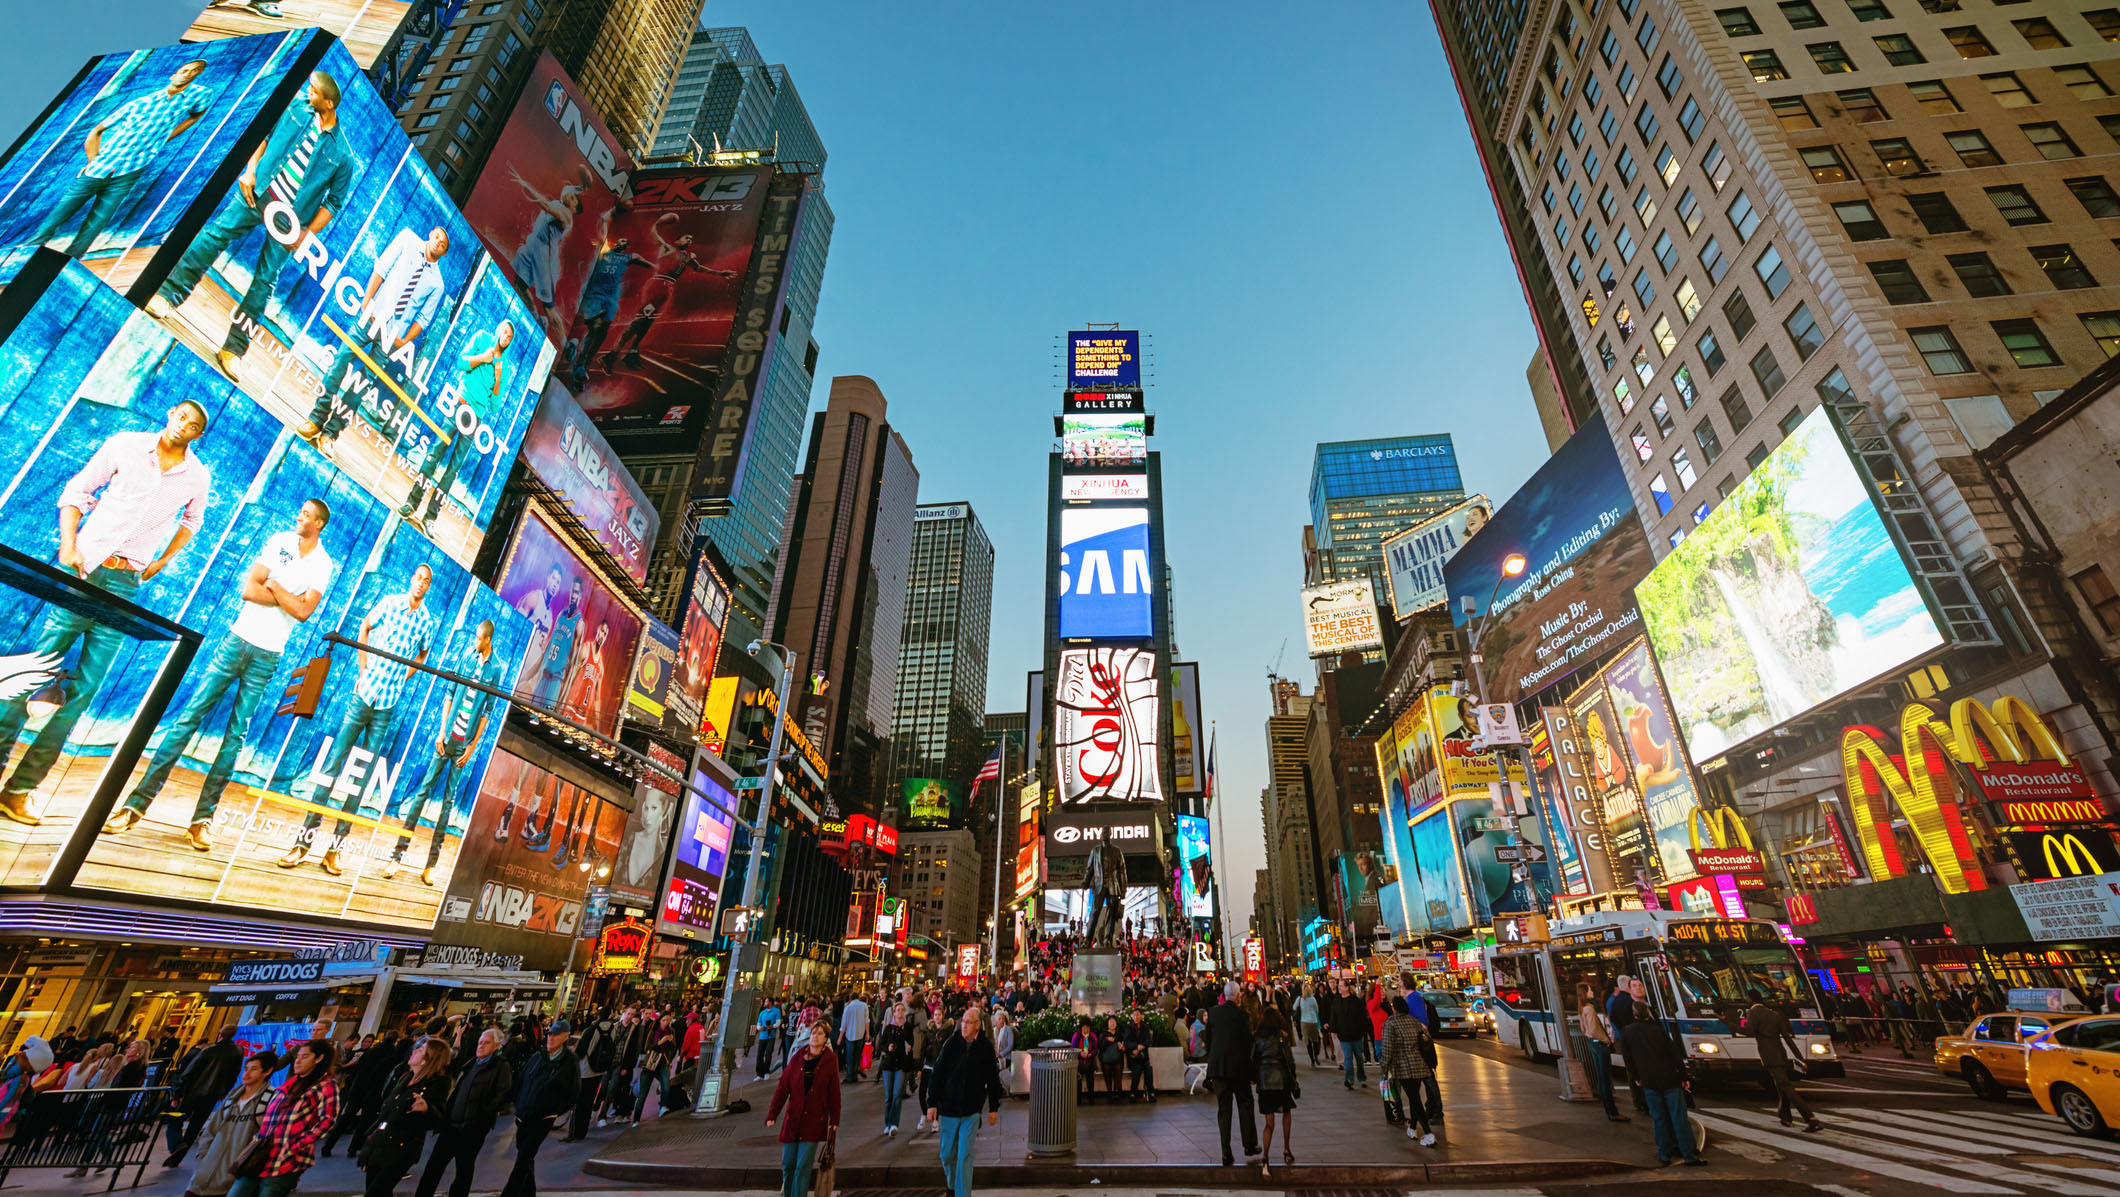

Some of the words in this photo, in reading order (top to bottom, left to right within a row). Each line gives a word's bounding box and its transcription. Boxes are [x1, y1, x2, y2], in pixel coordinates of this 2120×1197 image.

[557, 100, 635, 199] NBA
[700, 204, 730, 212] JAY
[753, 196, 798, 296] TIMES
[263, 200, 430, 397] ORIGINAL
[435, 382, 510, 467] BOOT
[1114, 339, 1127, 347] MY
[1075, 354, 1120, 362] SOMETHING
[1075, 369, 1119, 377] CHALLENGE
[710, 308, 766, 457] SQUARE
[228, 304, 327, 397] UNLIMITED
[329, 394, 371, 440] WAYS
[375, 434, 393, 457] TO
[395, 453, 433, 494] WEAR
[315, 343, 338, 375] 6
[341, 363, 431, 462] WASHES.
[1075, 400, 1132, 408] GALLERY
[567, 428, 609, 492] NBA
[1385, 445, 1446, 459] BARCLAYS
[1081, 479, 1129, 488] XINHUA
[914, 509, 946, 518] Allianz
[608, 519, 632, 548] JAY
[629, 542, 642, 560] Z
[1392, 525, 1457, 574] MAMMA
[1490, 569, 1542, 617] Photography
[1543, 552, 1561, 575] and
[1561, 524, 1601, 560] Editing
[1599, 507, 1620, 529] By:
[1533, 582, 1550, 602] Ross
[1550, 566, 1575, 588] Ching
[1309, 614, 1330, 623] BEST
[1333, 609, 1372, 619] MUSICAL
[1312, 621, 1337, 633] THE
[1340, 616, 1373, 628] BEST
[1539, 611, 1570, 640] Music
[1568, 601, 1588, 620] By:
[1312, 628, 1358, 641] MUSICAL
[1360, 625, 1374, 633] OF
[1313, 639, 1333, 647] THIS
[1536, 643, 1551, 660] The
[1551, 631, 1574, 650] Ghost
[1575, 608, 1604, 634] Orchid
[1519, 608, 1639, 689] MySpace.com/TheGhostOrchid
[638, 651, 661, 694] Q
[1064, 656, 1084, 703] Diet
[1078, 663, 1123, 787] Coke
[308, 735, 402, 801] LEN
[1471, 758, 1487, 768] You
[741, 779, 749, 788] 46
[1555, 716, 1602, 850] PALACE
[1983, 772, 2083, 787] McDonald's
[2005, 786, 2072, 796] Restaurant
[1602, 784, 1638, 824] Annie
[219, 808, 285, 836] STYLIST
[286, 824, 329, 847] FROM
[1698, 853, 1760, 865] McDonald's
[484, 884, 535, 927] NBA
[1674, 924, 1700, 939] M104
[1730, 924, 1744, 939] ST
[438, 944, 456, 963] HOT
[456, 946, 480, 964] DOGS
[962, 947, 976, 977] tkts
[1247, 941, 1262, 971] tkts
[229, 973, 250, 982] best
[250, 964, 280, 981] HOT
[279, 962, 320, 981] DOGS
[226, 994, 239, 1002] HOT
